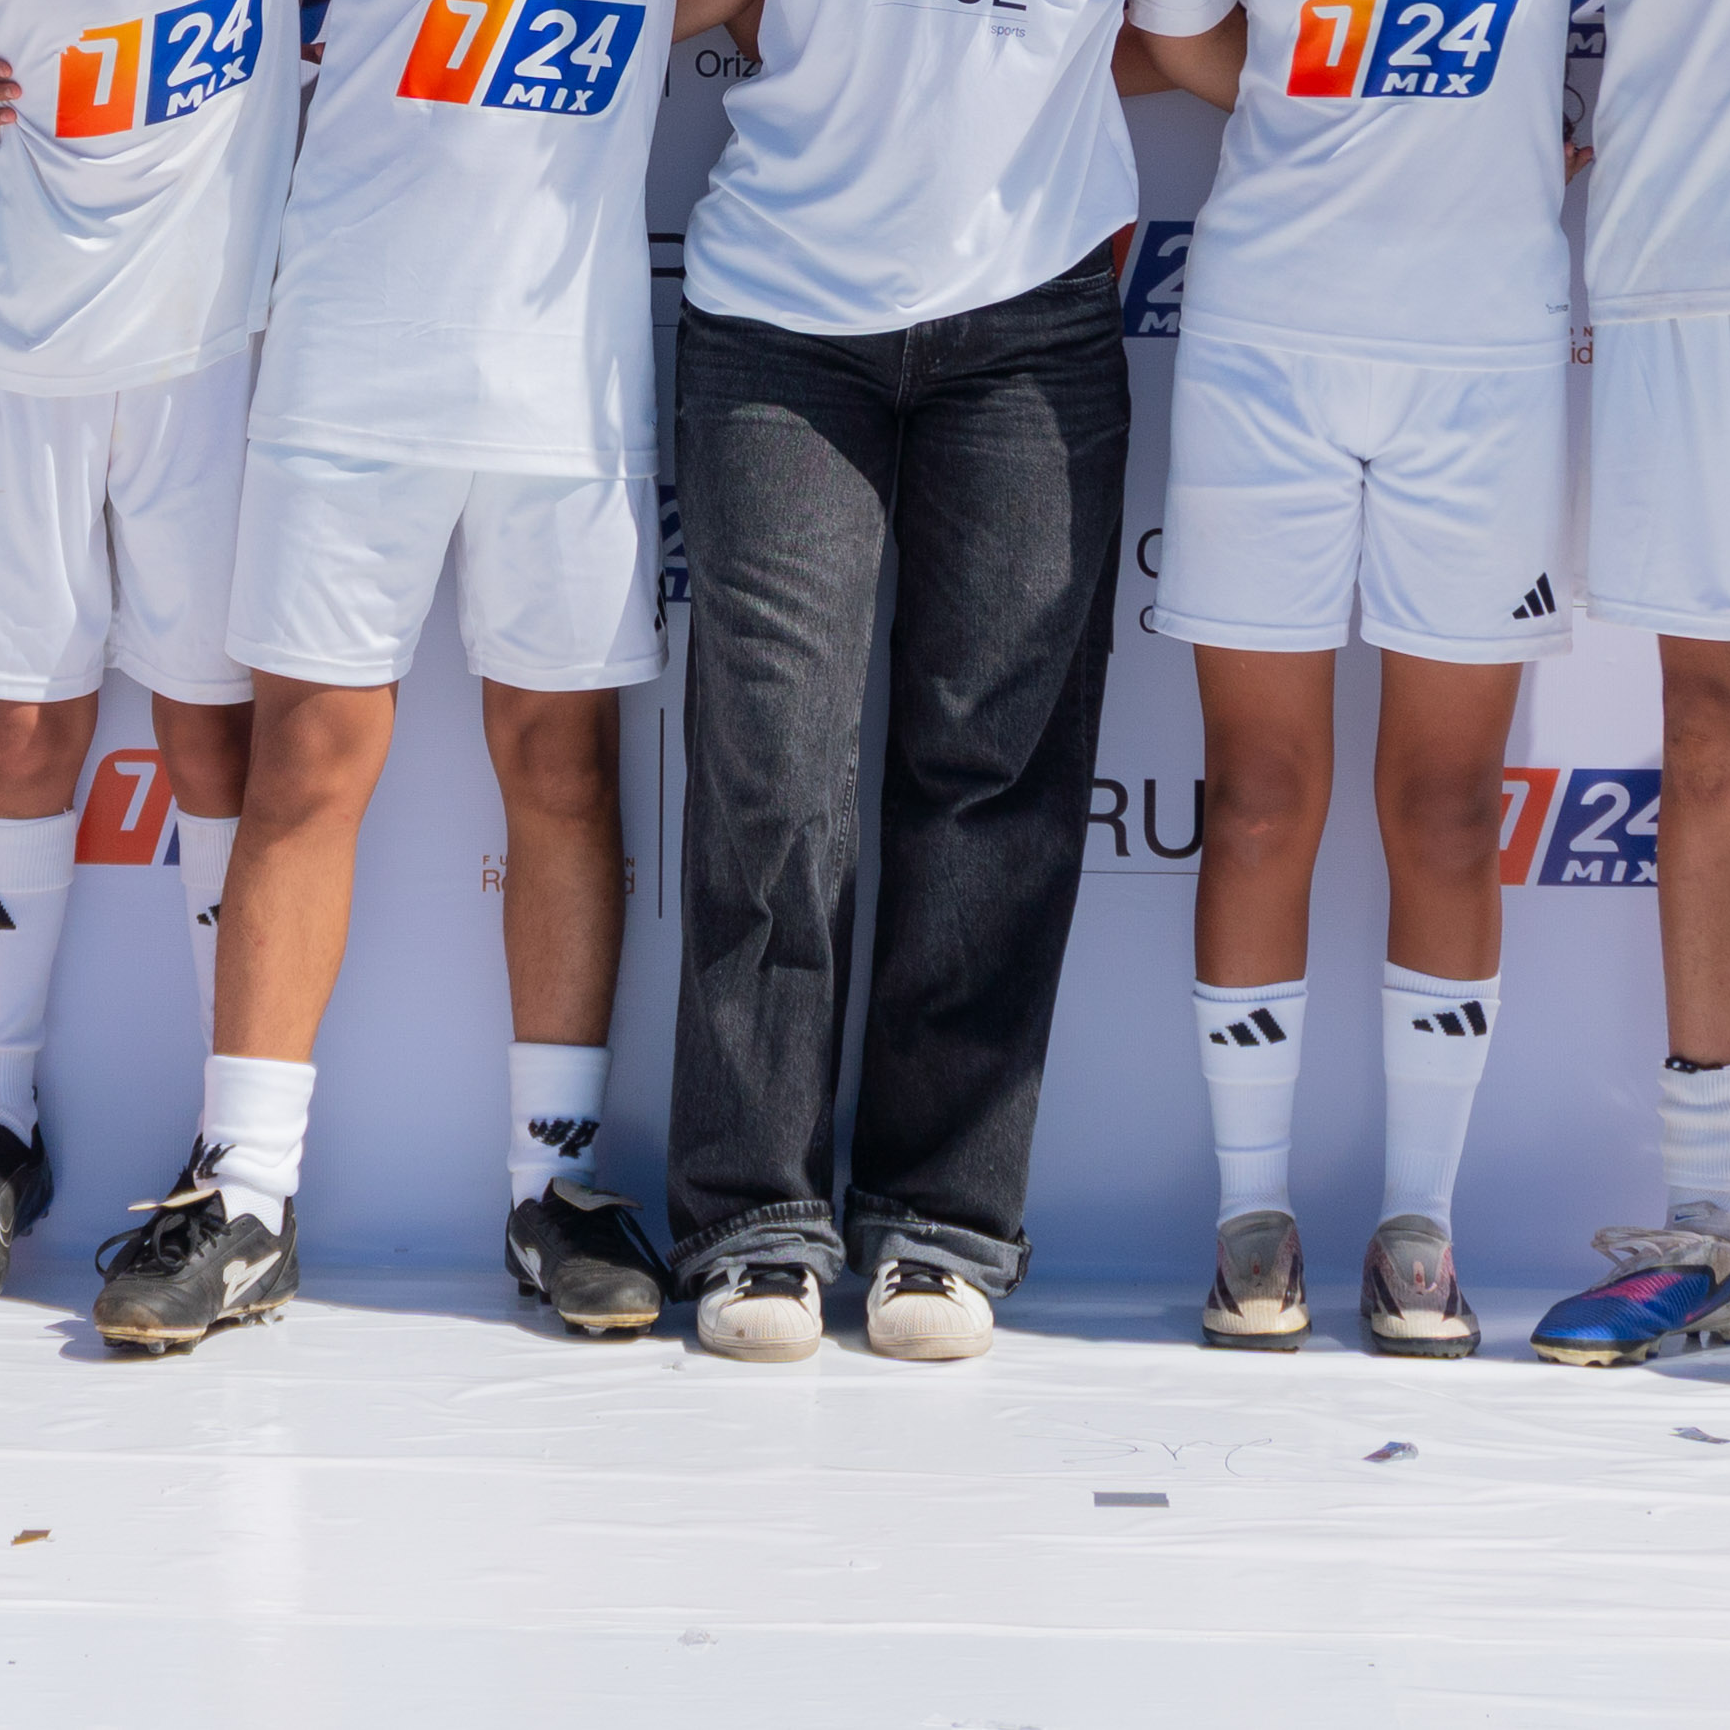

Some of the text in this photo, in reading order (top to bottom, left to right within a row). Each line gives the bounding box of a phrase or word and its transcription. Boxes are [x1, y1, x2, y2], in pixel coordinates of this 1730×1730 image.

[514, 3, 613, 80] 24
[990, 24, 1027, 42] sports
[1392, 3, 1494, 68] 24
[695, 50, 757, 78] Oriz
[166, 57, 251, 117] MIX
[503, 83, 596, 113] MIX
[1381, 73, 1474, 96] MIX
[1561, 859, 1658, 883] MIX
